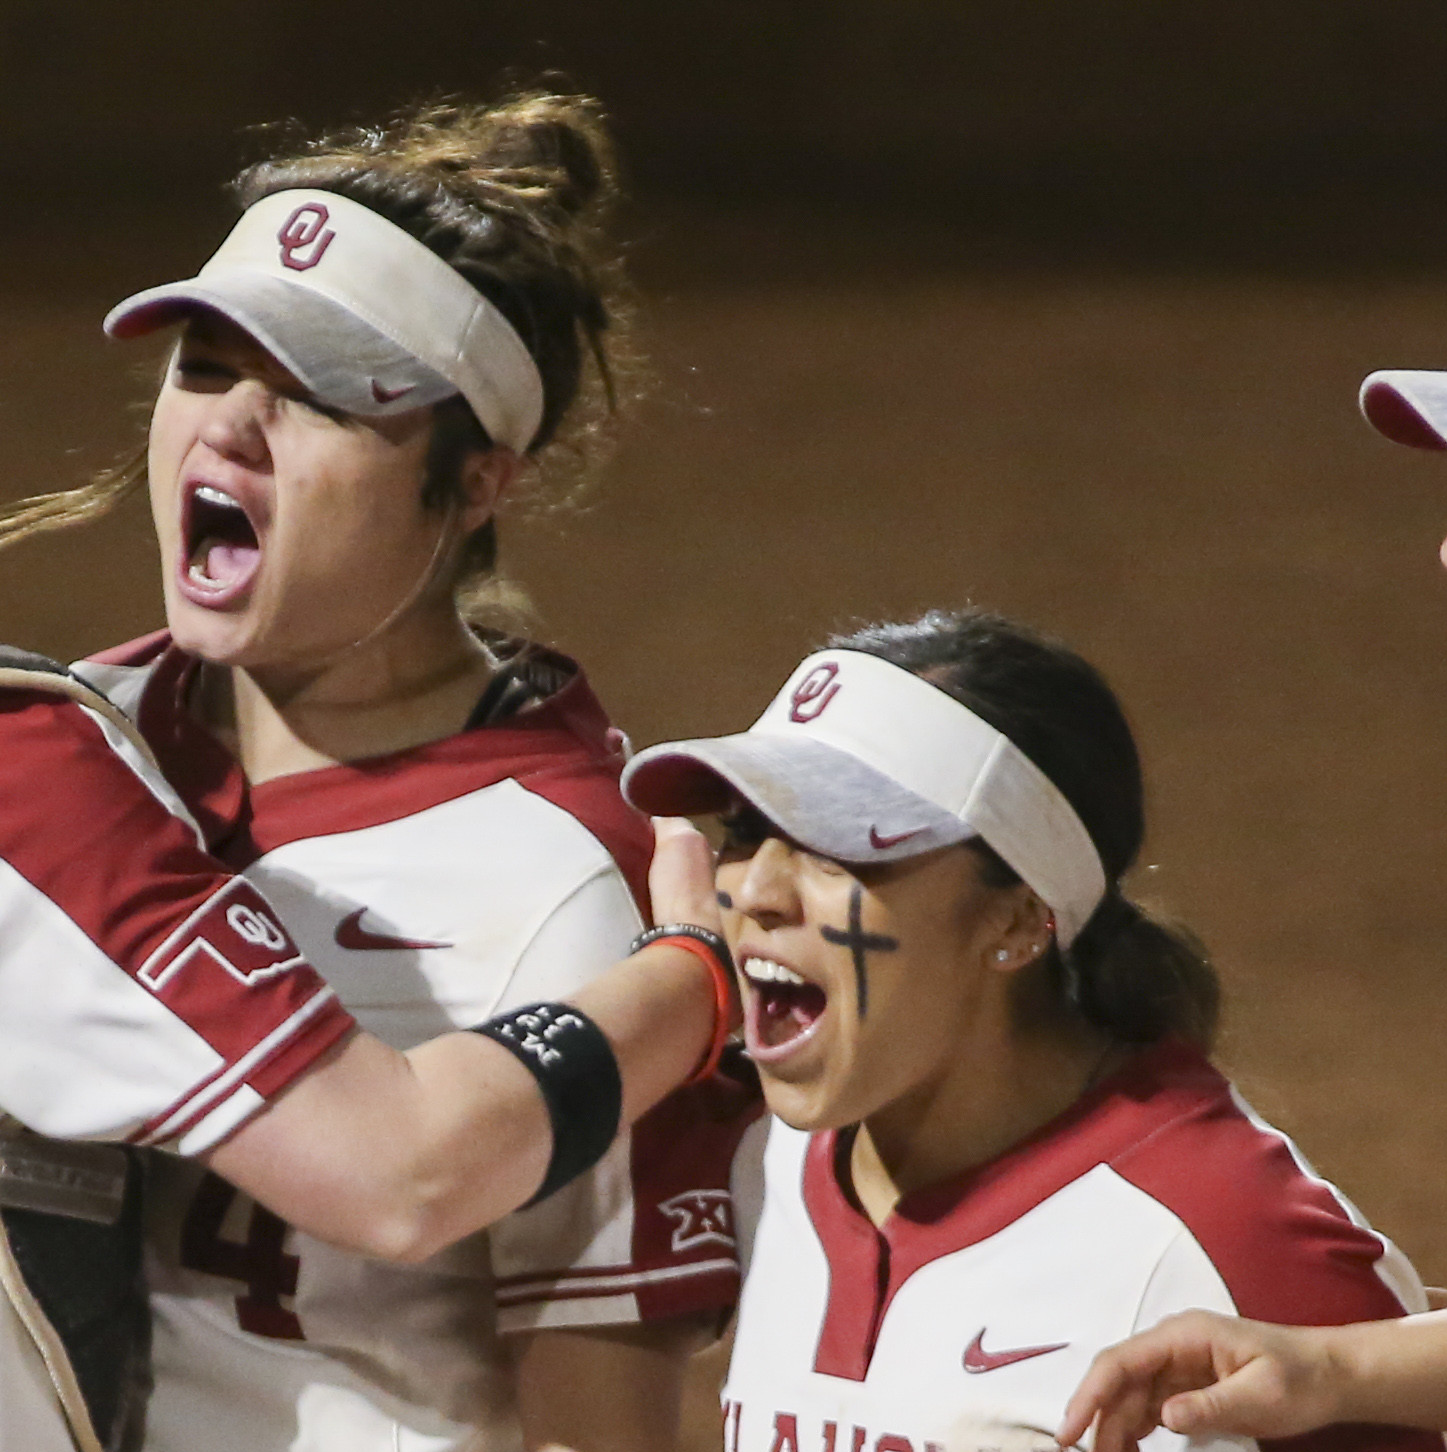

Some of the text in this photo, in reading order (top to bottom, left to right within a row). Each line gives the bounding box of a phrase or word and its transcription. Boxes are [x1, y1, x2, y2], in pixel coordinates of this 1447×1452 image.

[278, 203, 335, 270] OU
[789, 662, 841, 723] OU
[226, 904, 286, 951] OU
